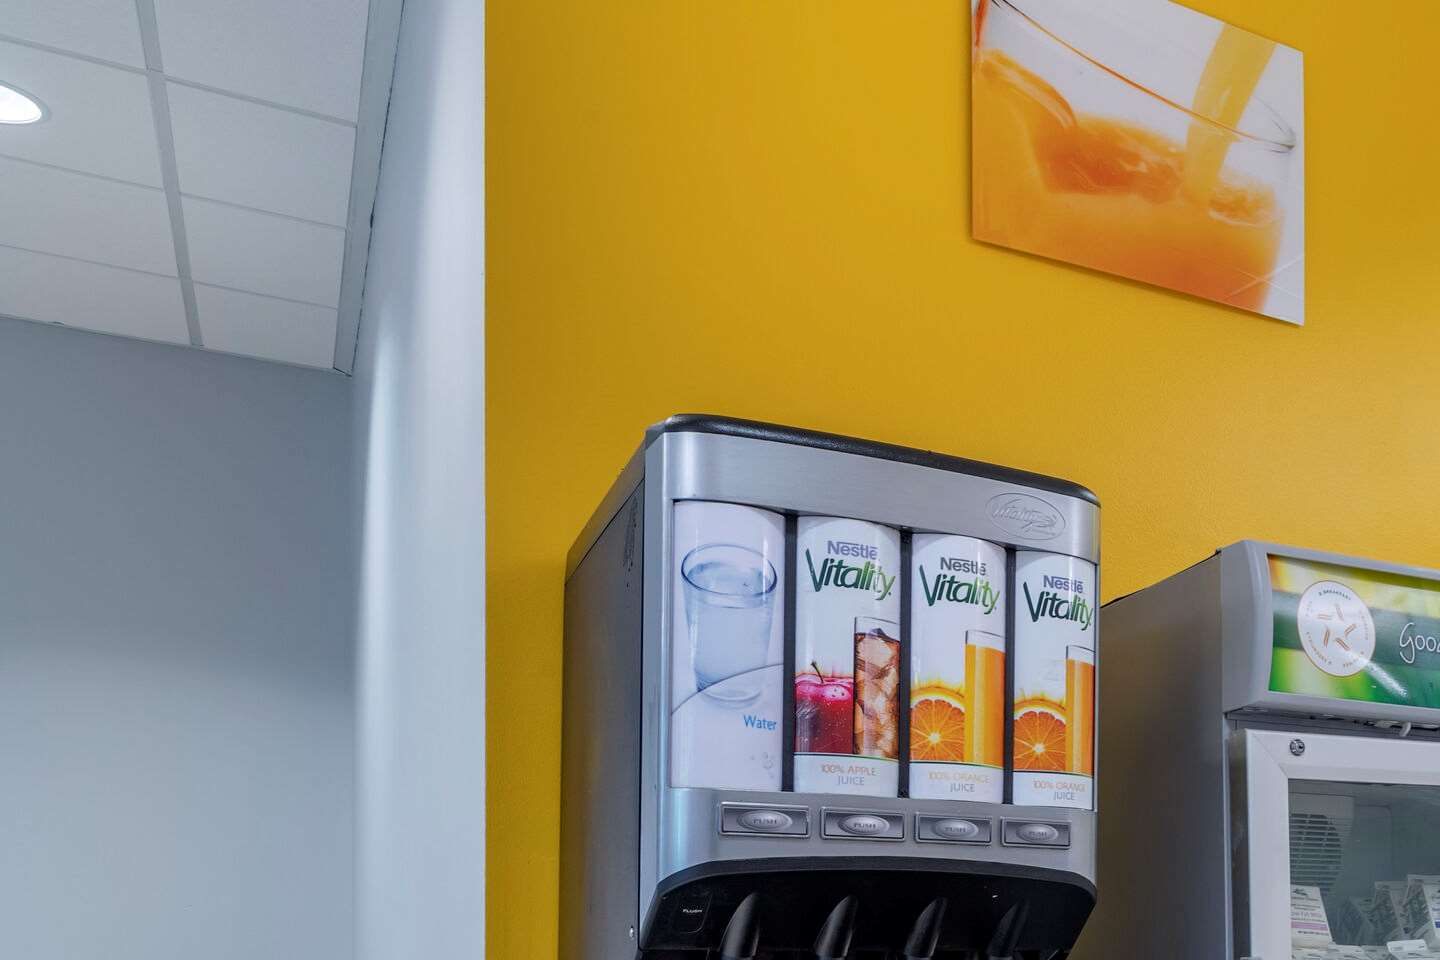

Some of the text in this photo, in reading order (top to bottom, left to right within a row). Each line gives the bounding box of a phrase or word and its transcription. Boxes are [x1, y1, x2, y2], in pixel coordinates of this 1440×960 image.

[805, 548, 896, 601] Vitality
[919, 565, 1000, 615] Vitality
[1023, 581, 1094, 631] Vitality
[743, 714, 777, 731] Water
[822, 763, 877, 777] 100% APPLE
[837, 775, 866, 786] JUICE
[953, 772, 991, 785] ORANGE
[950, 782, 976, 793] JUICE
[1056, 781, 1088, 793] ORANGE
[1053, 791, 1076, 801] JUICE
